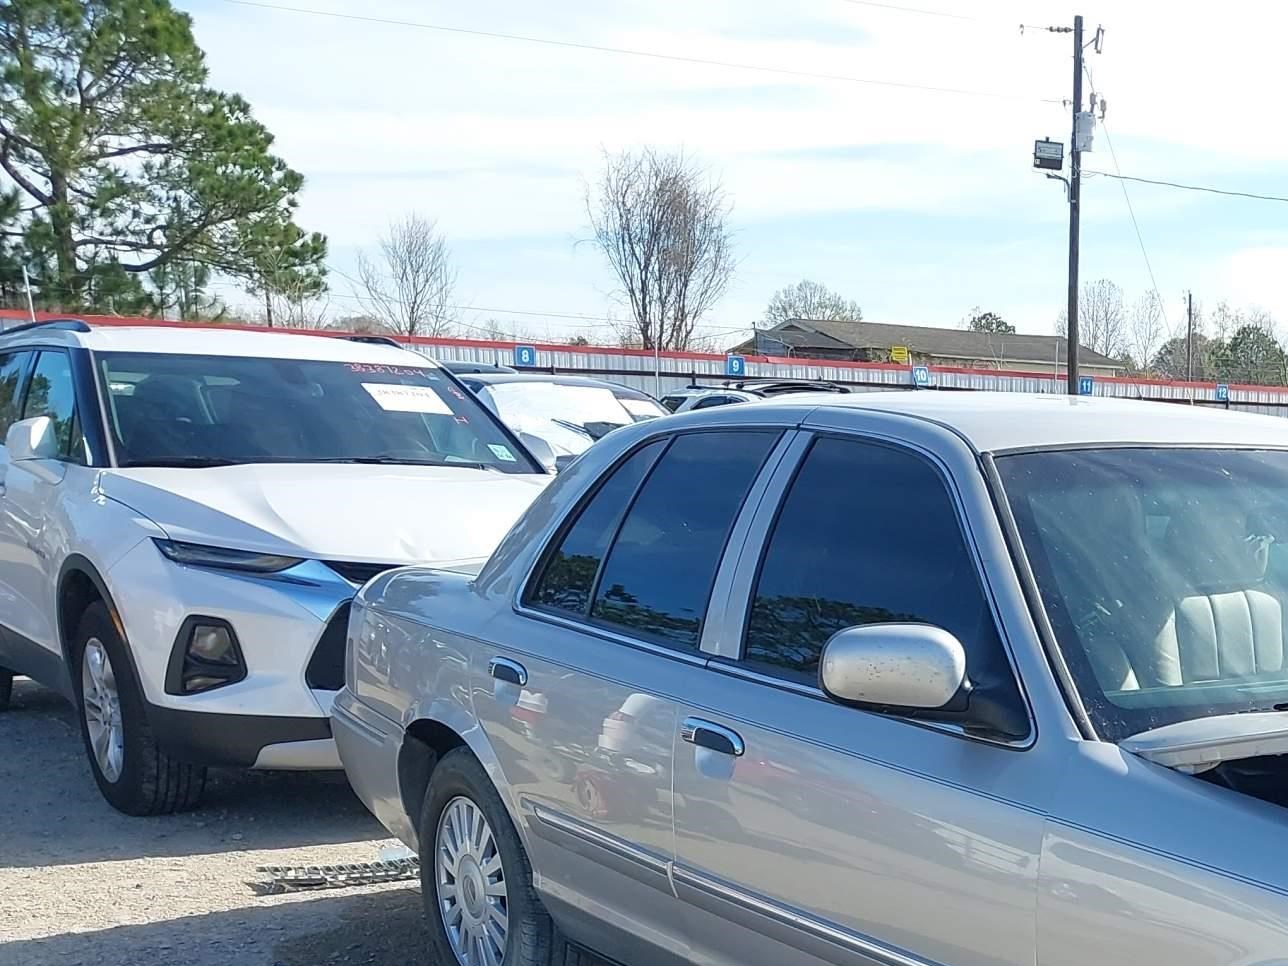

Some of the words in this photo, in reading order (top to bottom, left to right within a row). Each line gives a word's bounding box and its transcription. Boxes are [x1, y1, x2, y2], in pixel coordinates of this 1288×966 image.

[521, 349, 530, 363] 8
[732, 359, 741, 372] 9
[915, 368, 928, 382] 10
[1082, 381, 1092, 393] 11
[1218, 387, 1228, 399] 12
